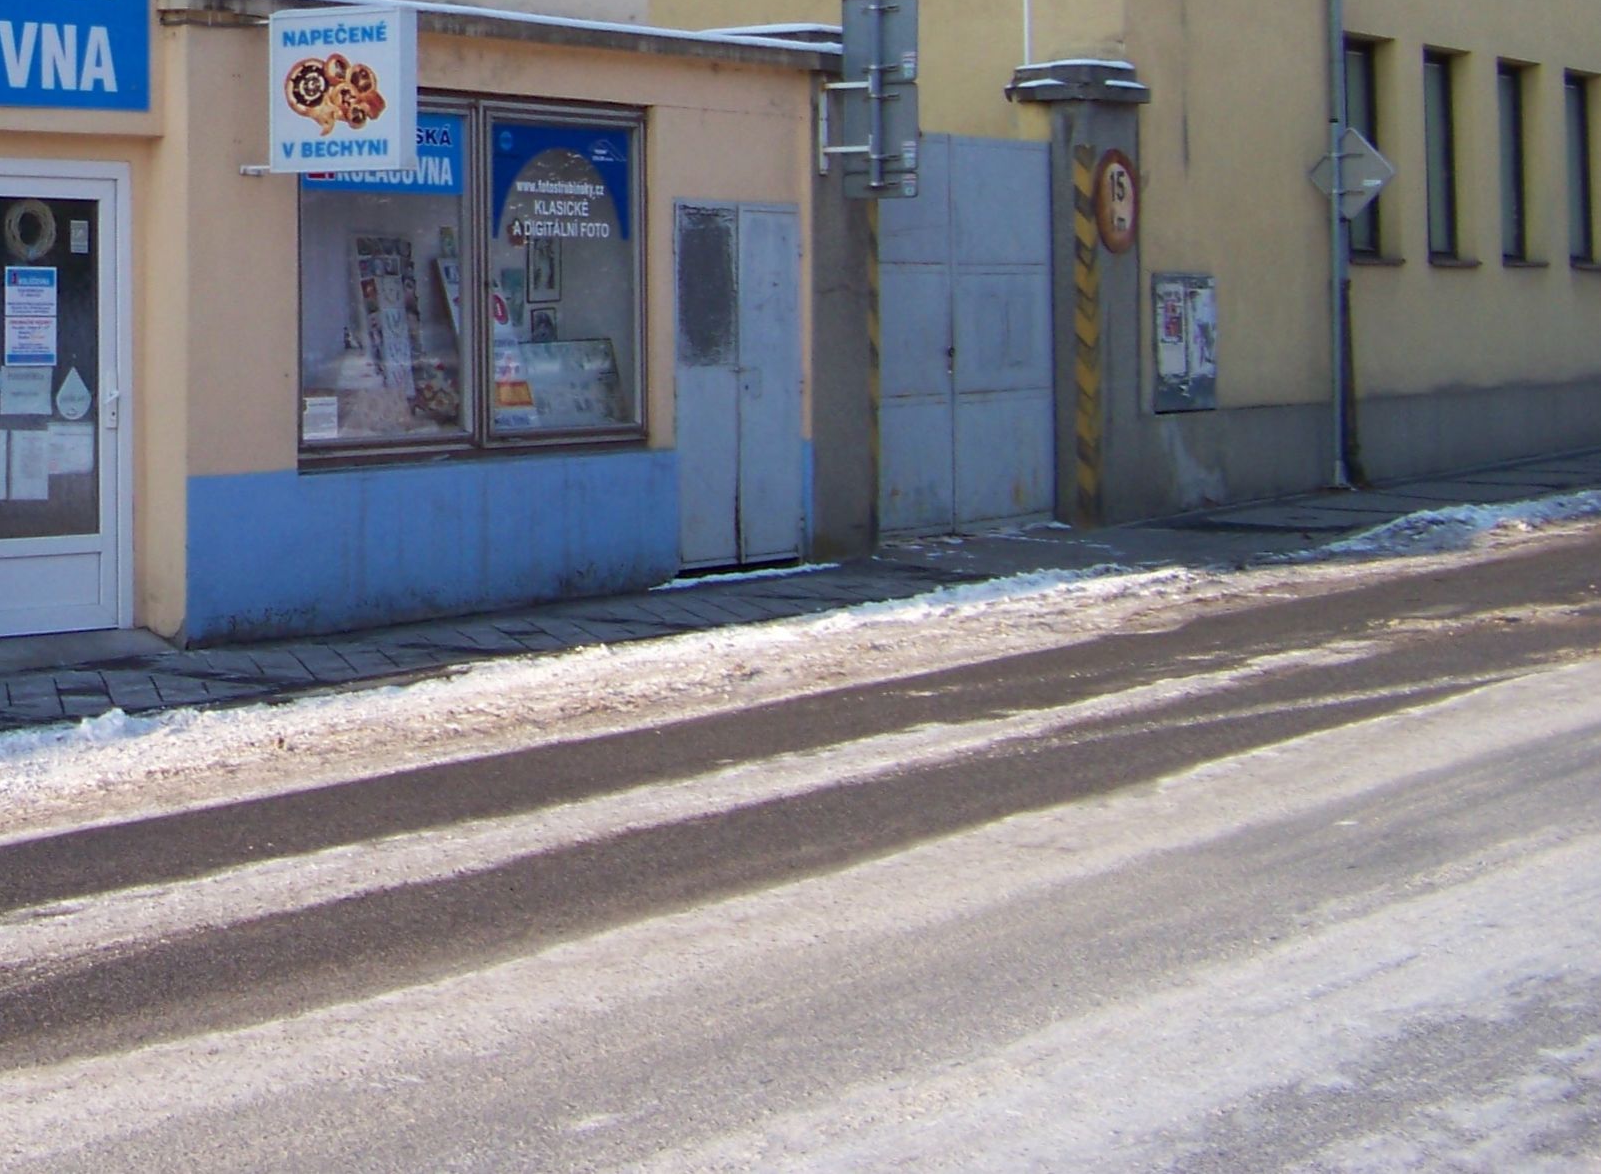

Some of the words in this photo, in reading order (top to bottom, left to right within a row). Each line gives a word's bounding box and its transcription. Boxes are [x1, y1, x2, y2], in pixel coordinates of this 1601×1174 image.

[282, 20, 388, 48] NAPEČENÉ
[282, 142, 295, 159] V
[301, 138, 388, 159] BECHYNI
[1110, 170, 1125, 202] 15
[534, 198, 590, 217] KLASICKÉ
[513, 220, 522, 236] A
[524, 219, 578, 238] DIGITÁLNÍ
[580, 222, 610, 238] FOTO
